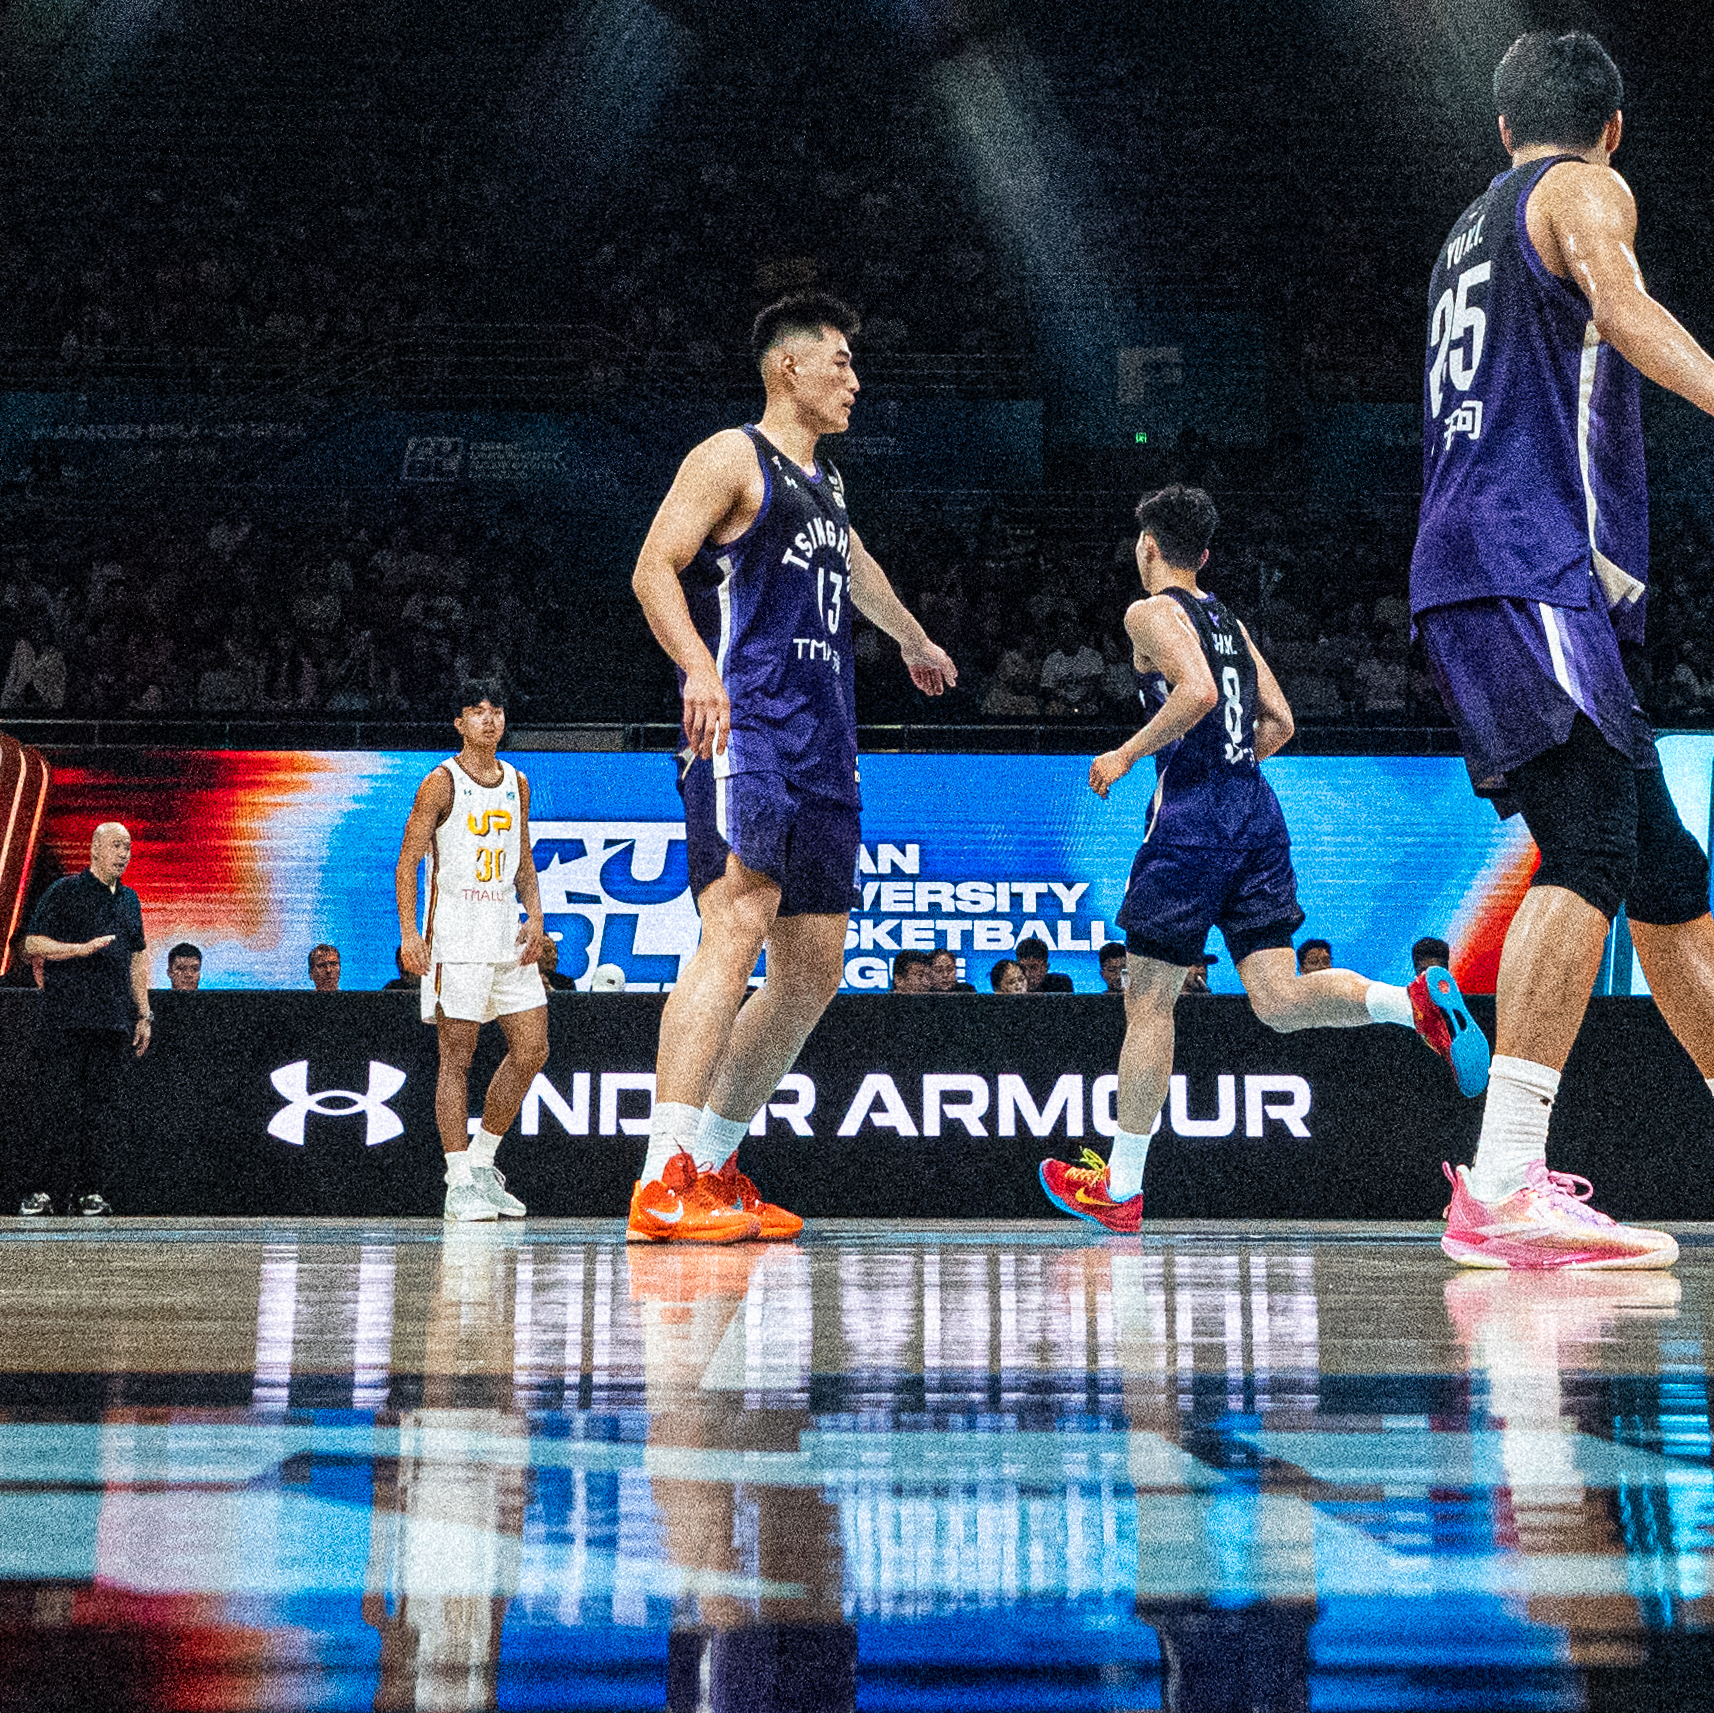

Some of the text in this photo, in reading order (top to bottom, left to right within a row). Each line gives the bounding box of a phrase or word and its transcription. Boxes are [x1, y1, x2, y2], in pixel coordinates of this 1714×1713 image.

[1429, 260, 1491, 419] 25
[781, 517, 851, 592] TSINGH
[817, 568, 843, 635] 13
[1222, 666, 1243, 744] 8
[467, 1071, 815, 1137] NDR
